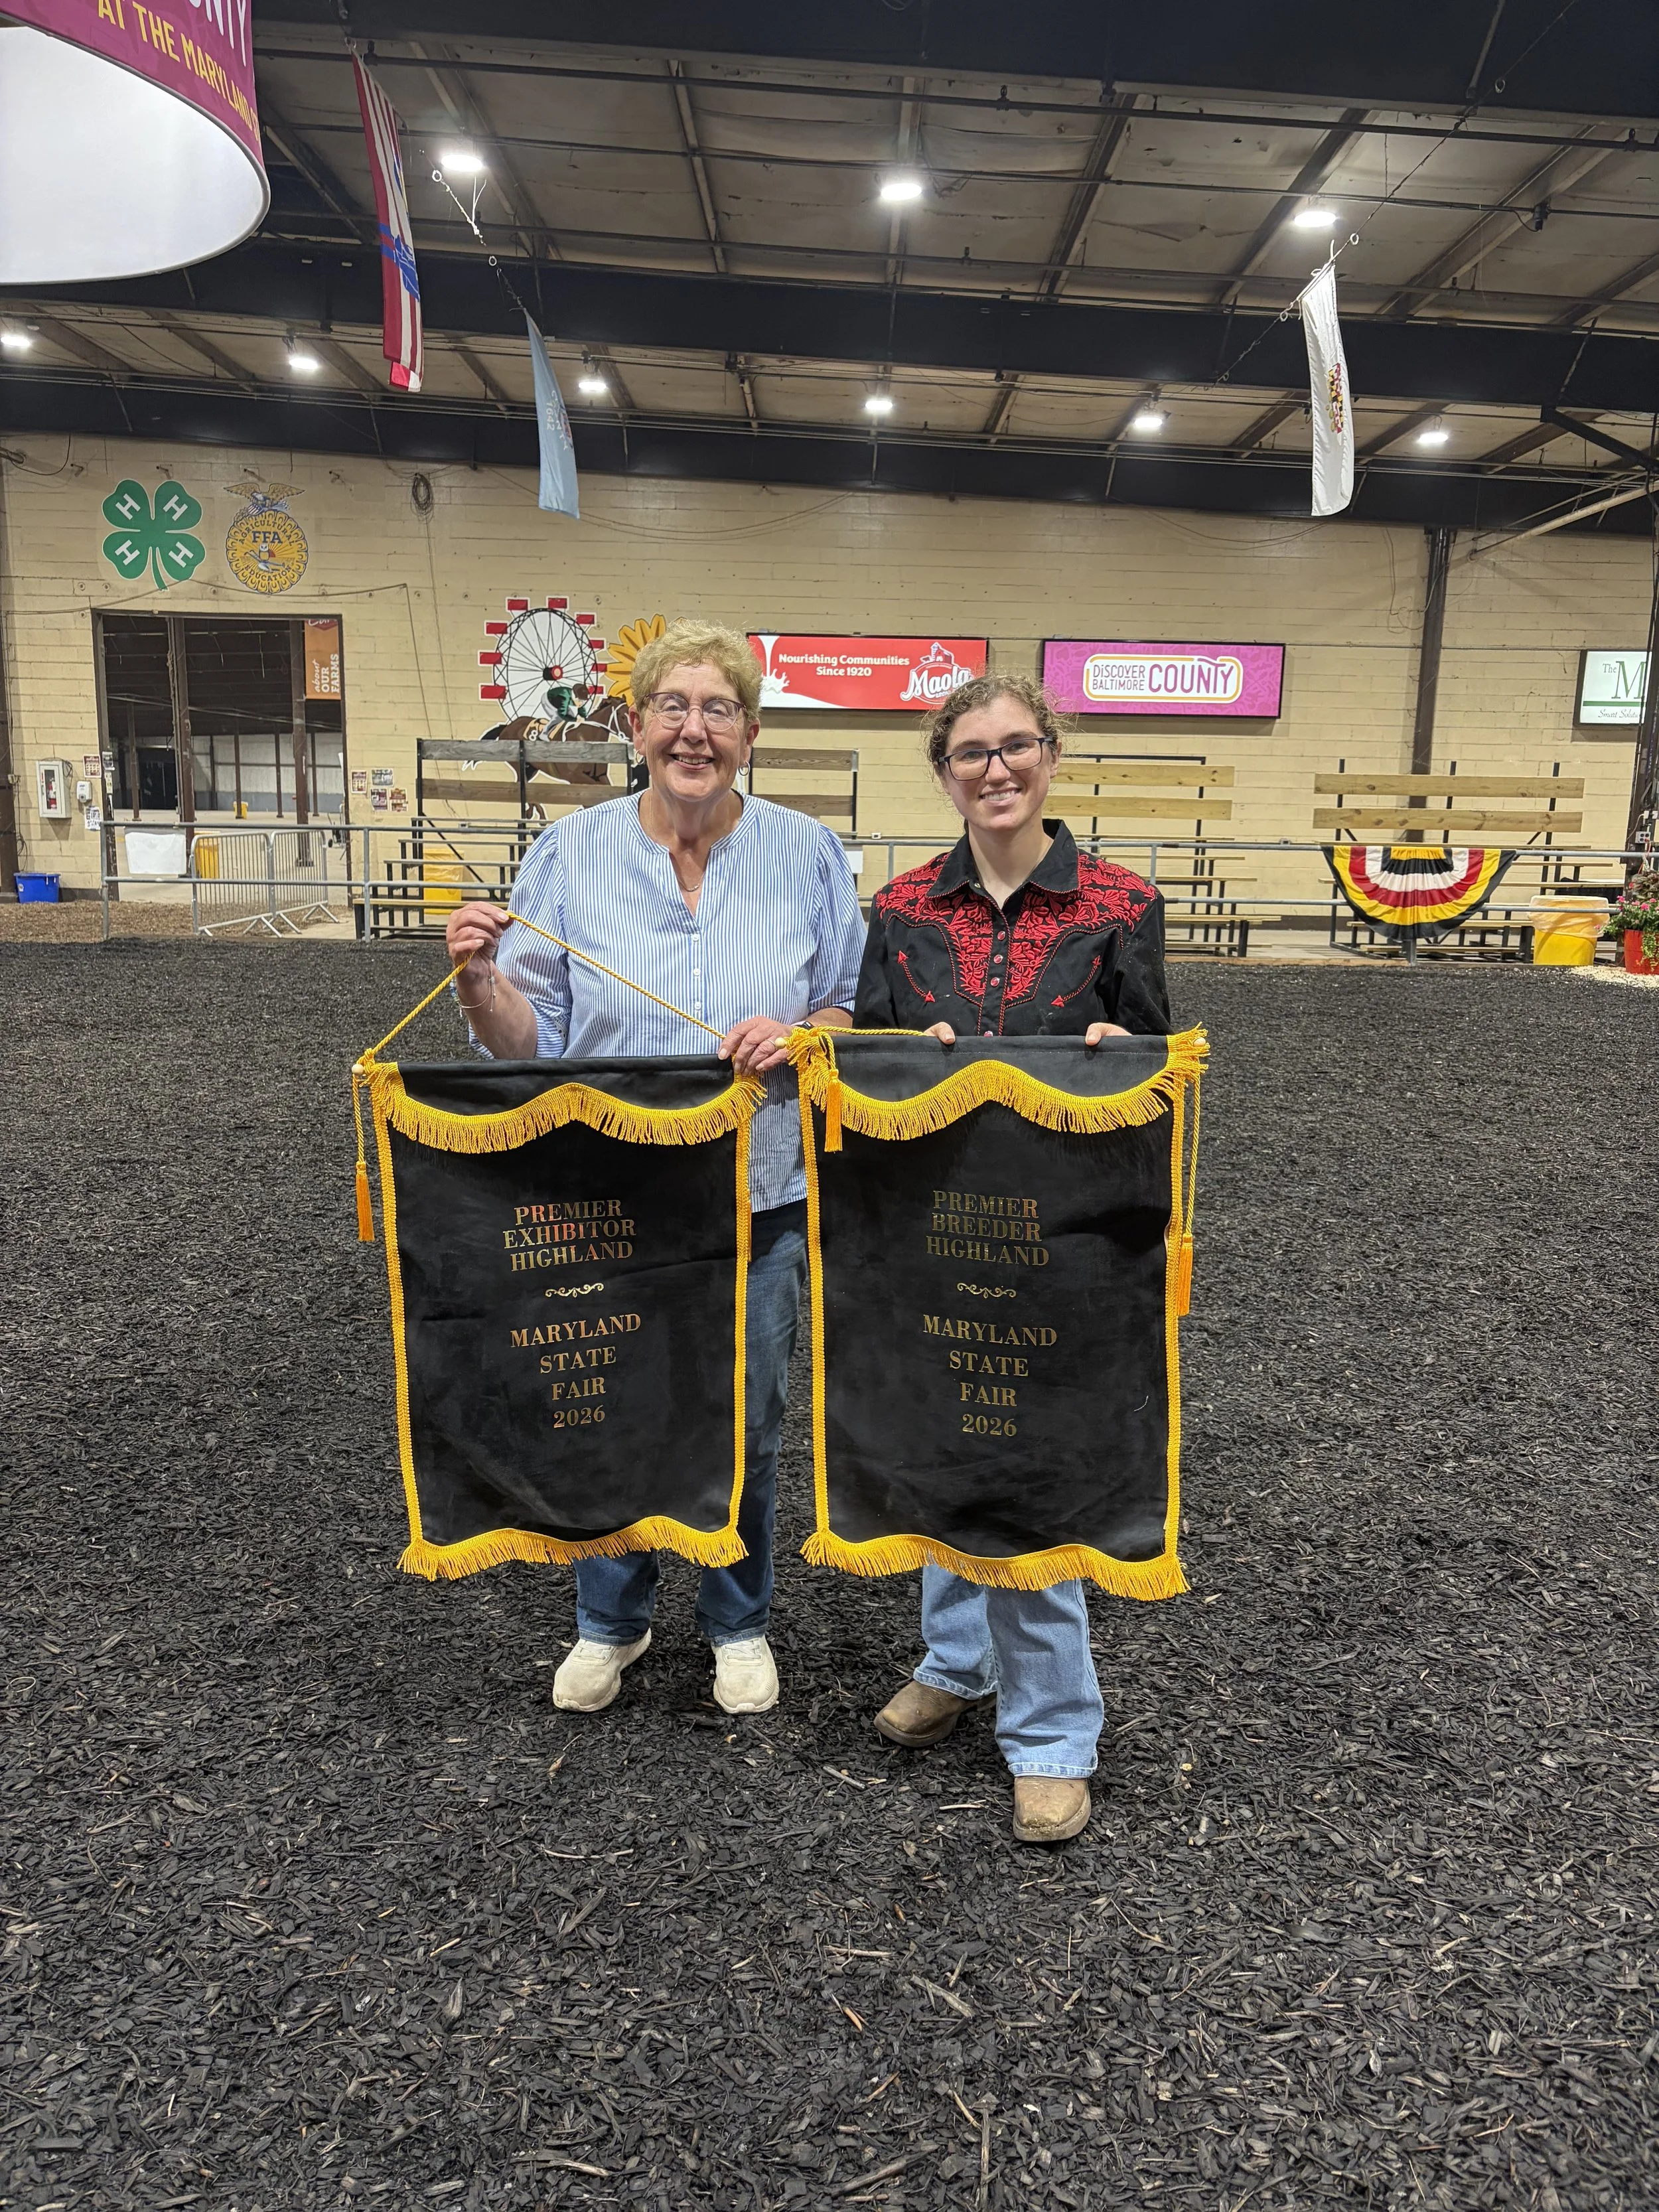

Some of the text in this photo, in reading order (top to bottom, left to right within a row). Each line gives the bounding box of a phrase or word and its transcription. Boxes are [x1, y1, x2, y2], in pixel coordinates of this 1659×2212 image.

[98, 0, 125, 30] AT
[133, 1, 180, 62] THE
[180, 33, 252, 131] MARYLAND
[546, 402, 555, 430] 1642
[115, 493, 188, 520] H H
[238, 520, 295, 546] AGRICULTURAL
[252, 531, 283, 544] FFA
[115, 540, 193, 567] H H
[244, 564, 292, 581] EDUCATION
[778, 653, 910, 666] Nourishing Communities
[816, 666, 872, 677] Since 1920
[311, 658, 320, 692] about
[321, 667, 330, 693] OUR
[330, 654, 340, 693] FARMS
[901, 666, 972, 700] Maola
[1092, 679, 1145, 690] BALTIMORE
[1148, 657, 1234, 694] COUNTY
[1602, 661, 1646, 699] The M
[1598, 709, 1617, 717] Smart
[514, 1199, 622, 1226] PREMIER
[933, 1190, 1039, 1218] PREMIER
[502, 1219, 636, 1249] EXHIBITOR
[932, 1213, 1042, 1242] BREEDER
[510, 1241, 633, 1272] HIGHLAND
[926, 1236, 1049, 1266] HIGHLAND
[510, 1313, 641, 1348] MARYLAND
[923, 1314, 1058, 1347] MARYLAND
[540, 1346, 616, 1374] STATE
[949, 1351, 1028, 1376] STATE
[551, 1376, 606, 1400] FAIR
[960, 1382, 1017, 1406] FAIR
[553, 1404, 605, 1428] 2026
[962, 1414, 1017, 1437] 2026
